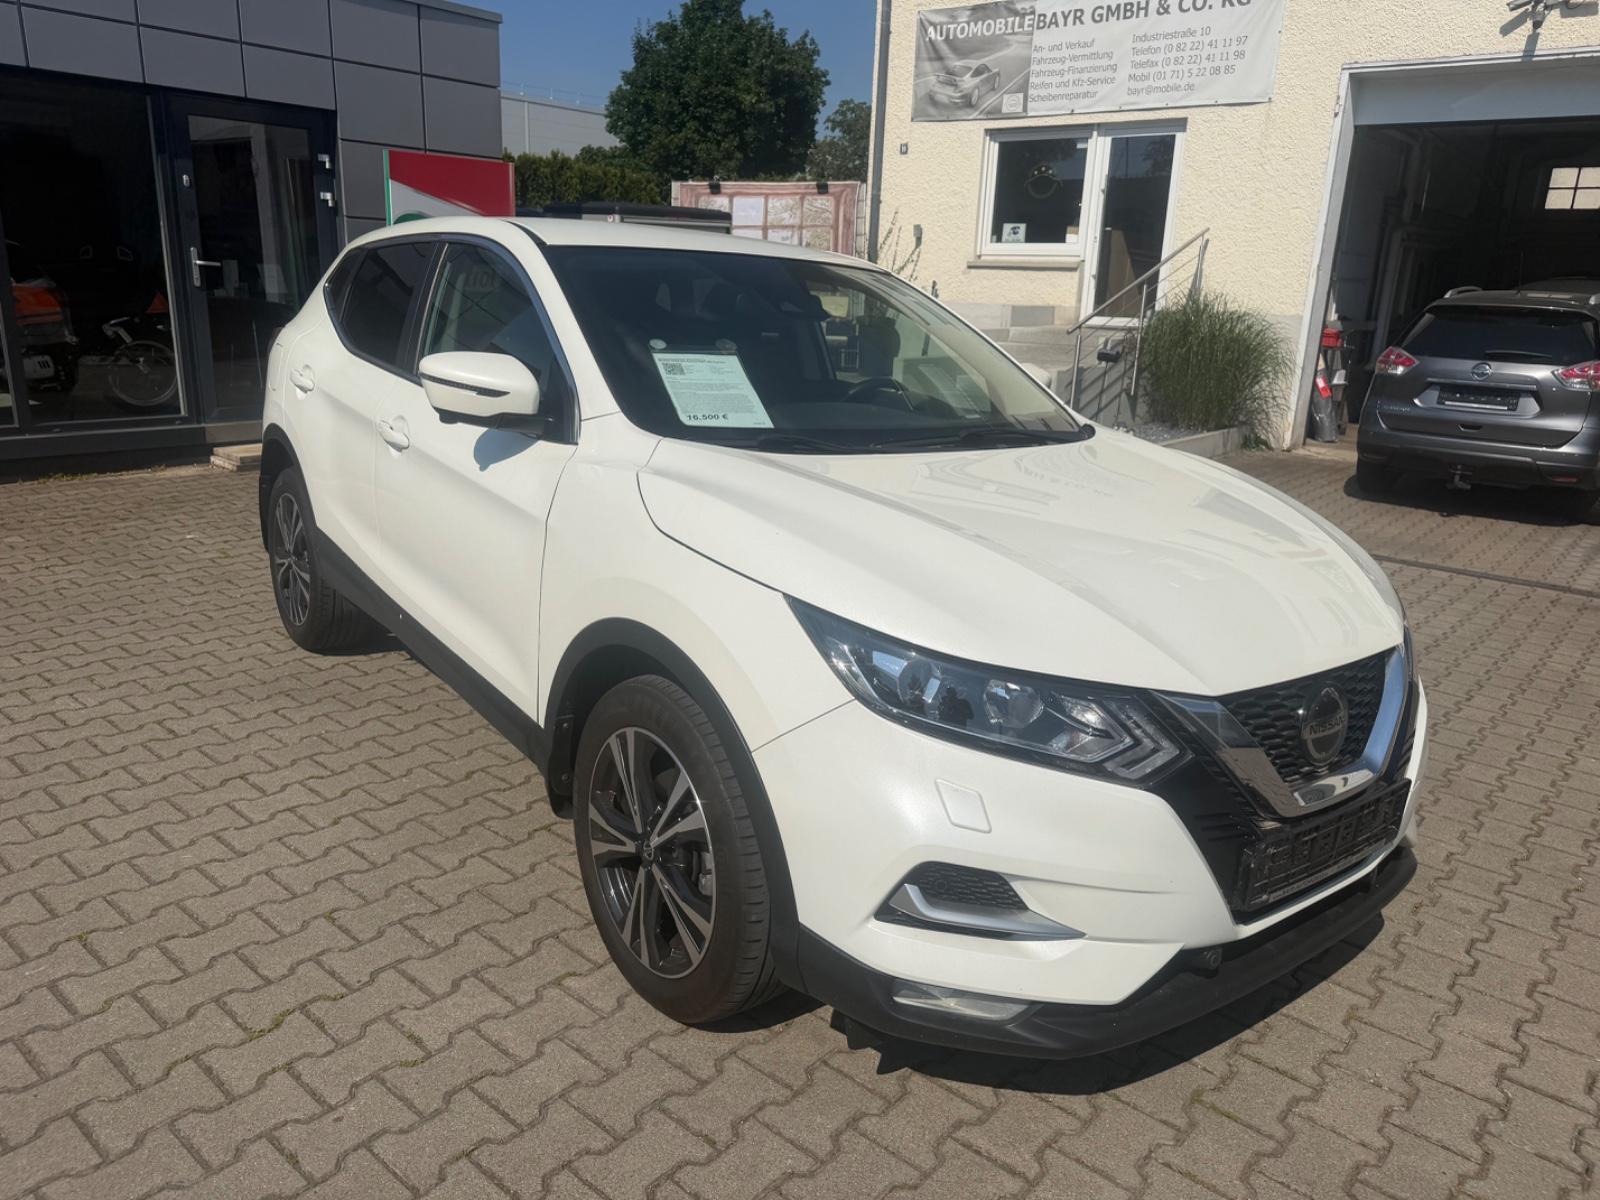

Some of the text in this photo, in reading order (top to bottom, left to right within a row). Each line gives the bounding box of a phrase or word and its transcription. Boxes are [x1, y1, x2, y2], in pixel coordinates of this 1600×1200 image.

[1091, 1, 1150, 24] GMBH
[1156, 0, 1171, 16] &
[1132, 26, 1211, 43] Industriestraße 10
[1033, 38, 1095, 53] An- und Verkauf
[1131, 35, 1248, 56] Telefon (0 82 22) 41 11 97
[1032, 51, 1114, 66] Fahrzeug-Vermittlung
[1130, 49, 1246, 70] Telefax (0 82 22) 41 11 98
[1128, 71, 1150, 82] Mobil
[1153, 70, 1166, 82] (01
[1170, 69, 1184, 80] 71)
[1195, 67, 1206, 77] 22
[1209, 65, 1221, 76] 08
[1224, 63, 1236, 75] 85
[1030, 76, 1117, 91] Reifen und Kfz-Service
[1126, 82, 1195, 97] bayr@mobile.de
[1028, 90, 1098, 103] Scheibenreparatur
[1309, 717, 1343, 736] NISSAN
